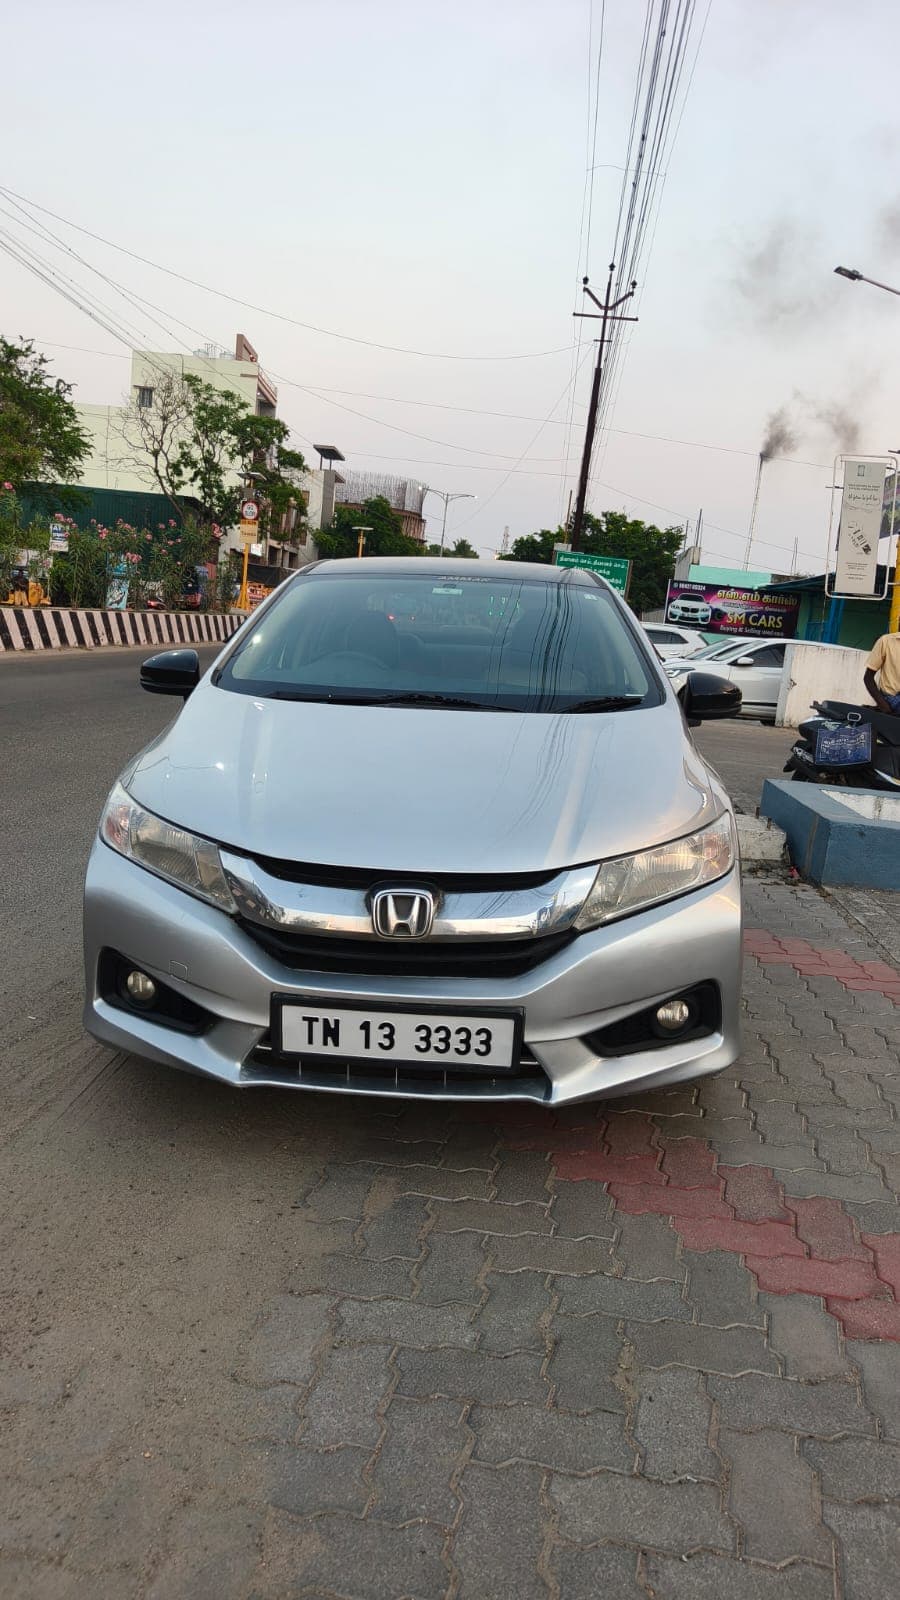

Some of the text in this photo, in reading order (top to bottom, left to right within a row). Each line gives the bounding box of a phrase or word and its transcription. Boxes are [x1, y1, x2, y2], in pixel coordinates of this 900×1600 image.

[726, 612, 783, 628] SM CARS
[302, 1016, 492, 1057] TN 13 3333
